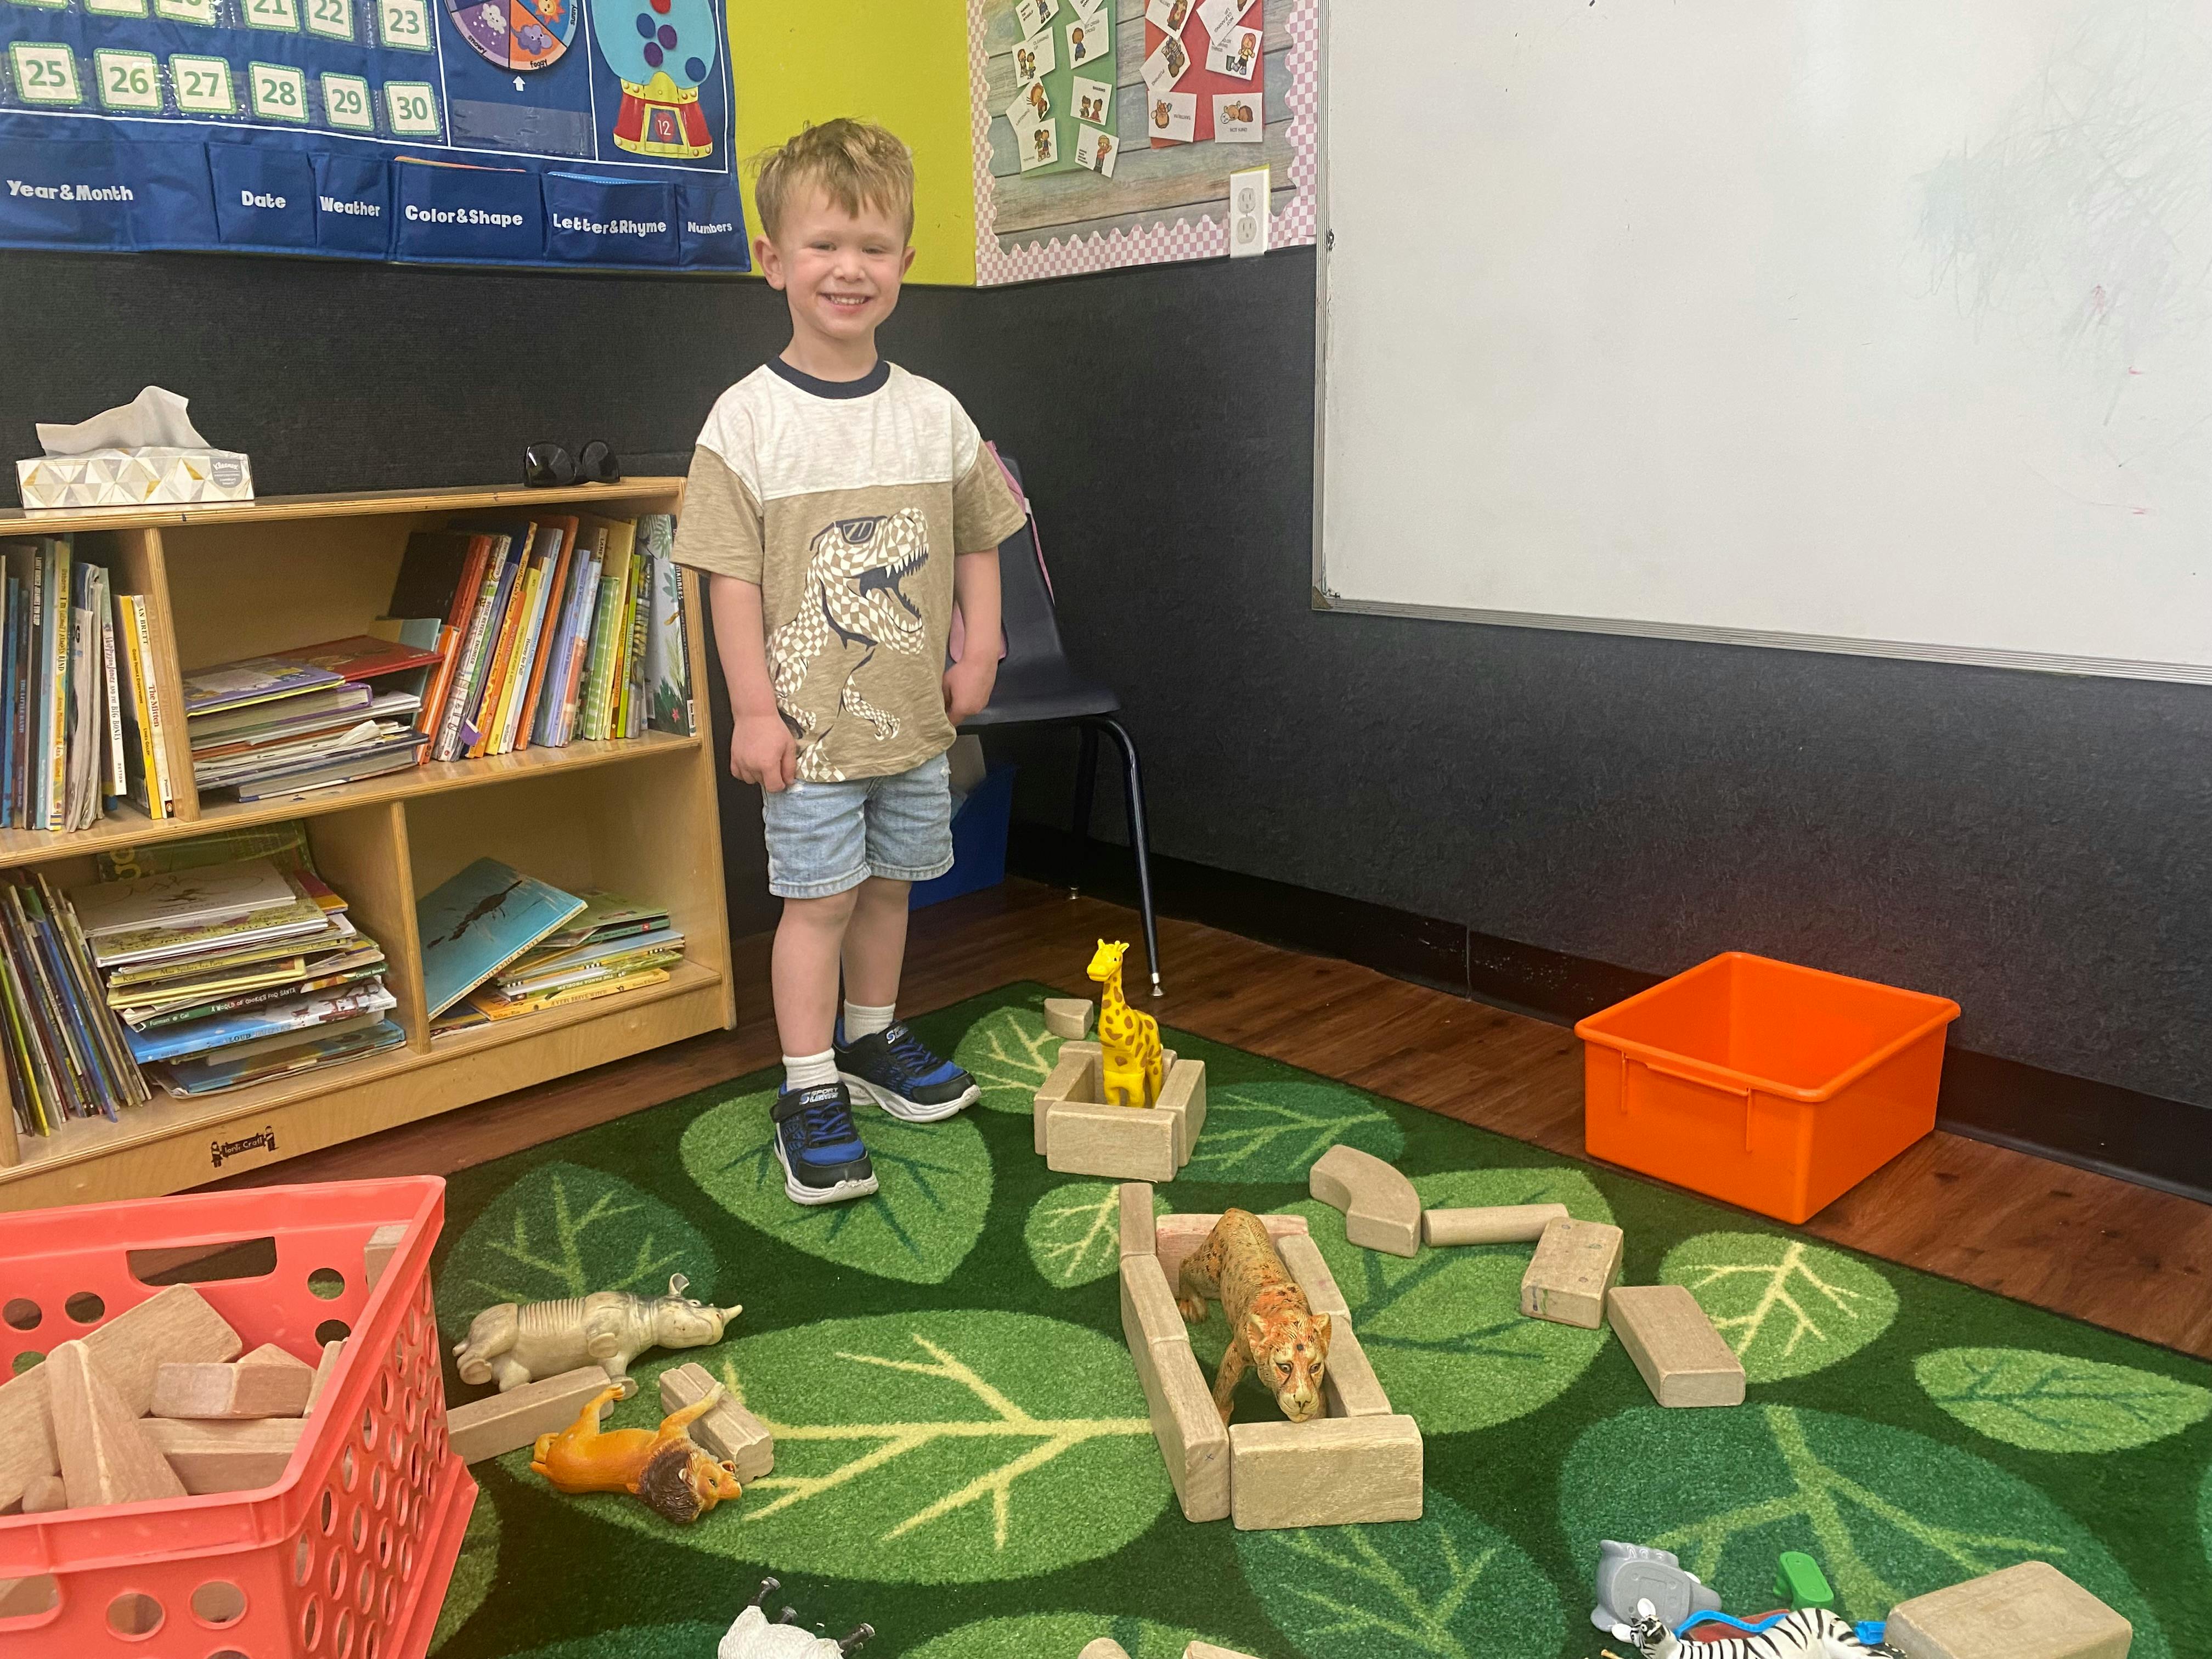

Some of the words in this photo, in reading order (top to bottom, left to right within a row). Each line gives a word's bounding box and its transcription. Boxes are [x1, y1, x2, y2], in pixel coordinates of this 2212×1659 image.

[314, 0, 344, 25] 22
[390, 8, 420, 35] 23
[467, 35, 487, 55] snowy
[530, 59, 548, 69] foggy
[26, 59, 66, 88] 25
[110, 66, 149, 94] 26
[184, 70, 219, 97] 27
[262, 79, 295, 106] 28
[333, 88, 361, 114] 29
[399, 97, 428, 120] 30
[658, 120, 671, 136] 12
[7, 180, 133, 201] Year&Month
[241, 190, 286, 209] Date
[319, 196, 381, 216] Weather
[405, 205, 523, 227] Color&Shape
[553, 213, 666, 237] Letter&Rhyme
[687, 222, 732, 234] Numbers
[212, 462, 238, 470] Kleenex
[516, 559, 527, 582] Giraffes
[483, 601, 492, 616] ROSIE
[507, 596, 516, 612] Dance
[139, 619, 148, 645] BRETT
[469, 639, 481, 664] ENGINEER
[522, 637, 531, 656] Hooray
[148, 684, 157, 699] The
[111, 706, 119, 718] BIG
[150, 701, 160, 727] Mitten
[112, 720, 121, 741] BONES
[515, 937, 539, 957] LUCKY
[371, 967, 386, 975] Books
[472, 956, 514, 988] DUCKLINGS
[557, 981, 584, 991] PROBLEM
[584, 977, 603, 985] PANDA
[245, 994, 267, 1005] COOKIES
[279, 987, 296, 996] SANTA
[228, 1032, 251, 1043] LOUD
[810, 1093, 838, 1103] LIGHTS
